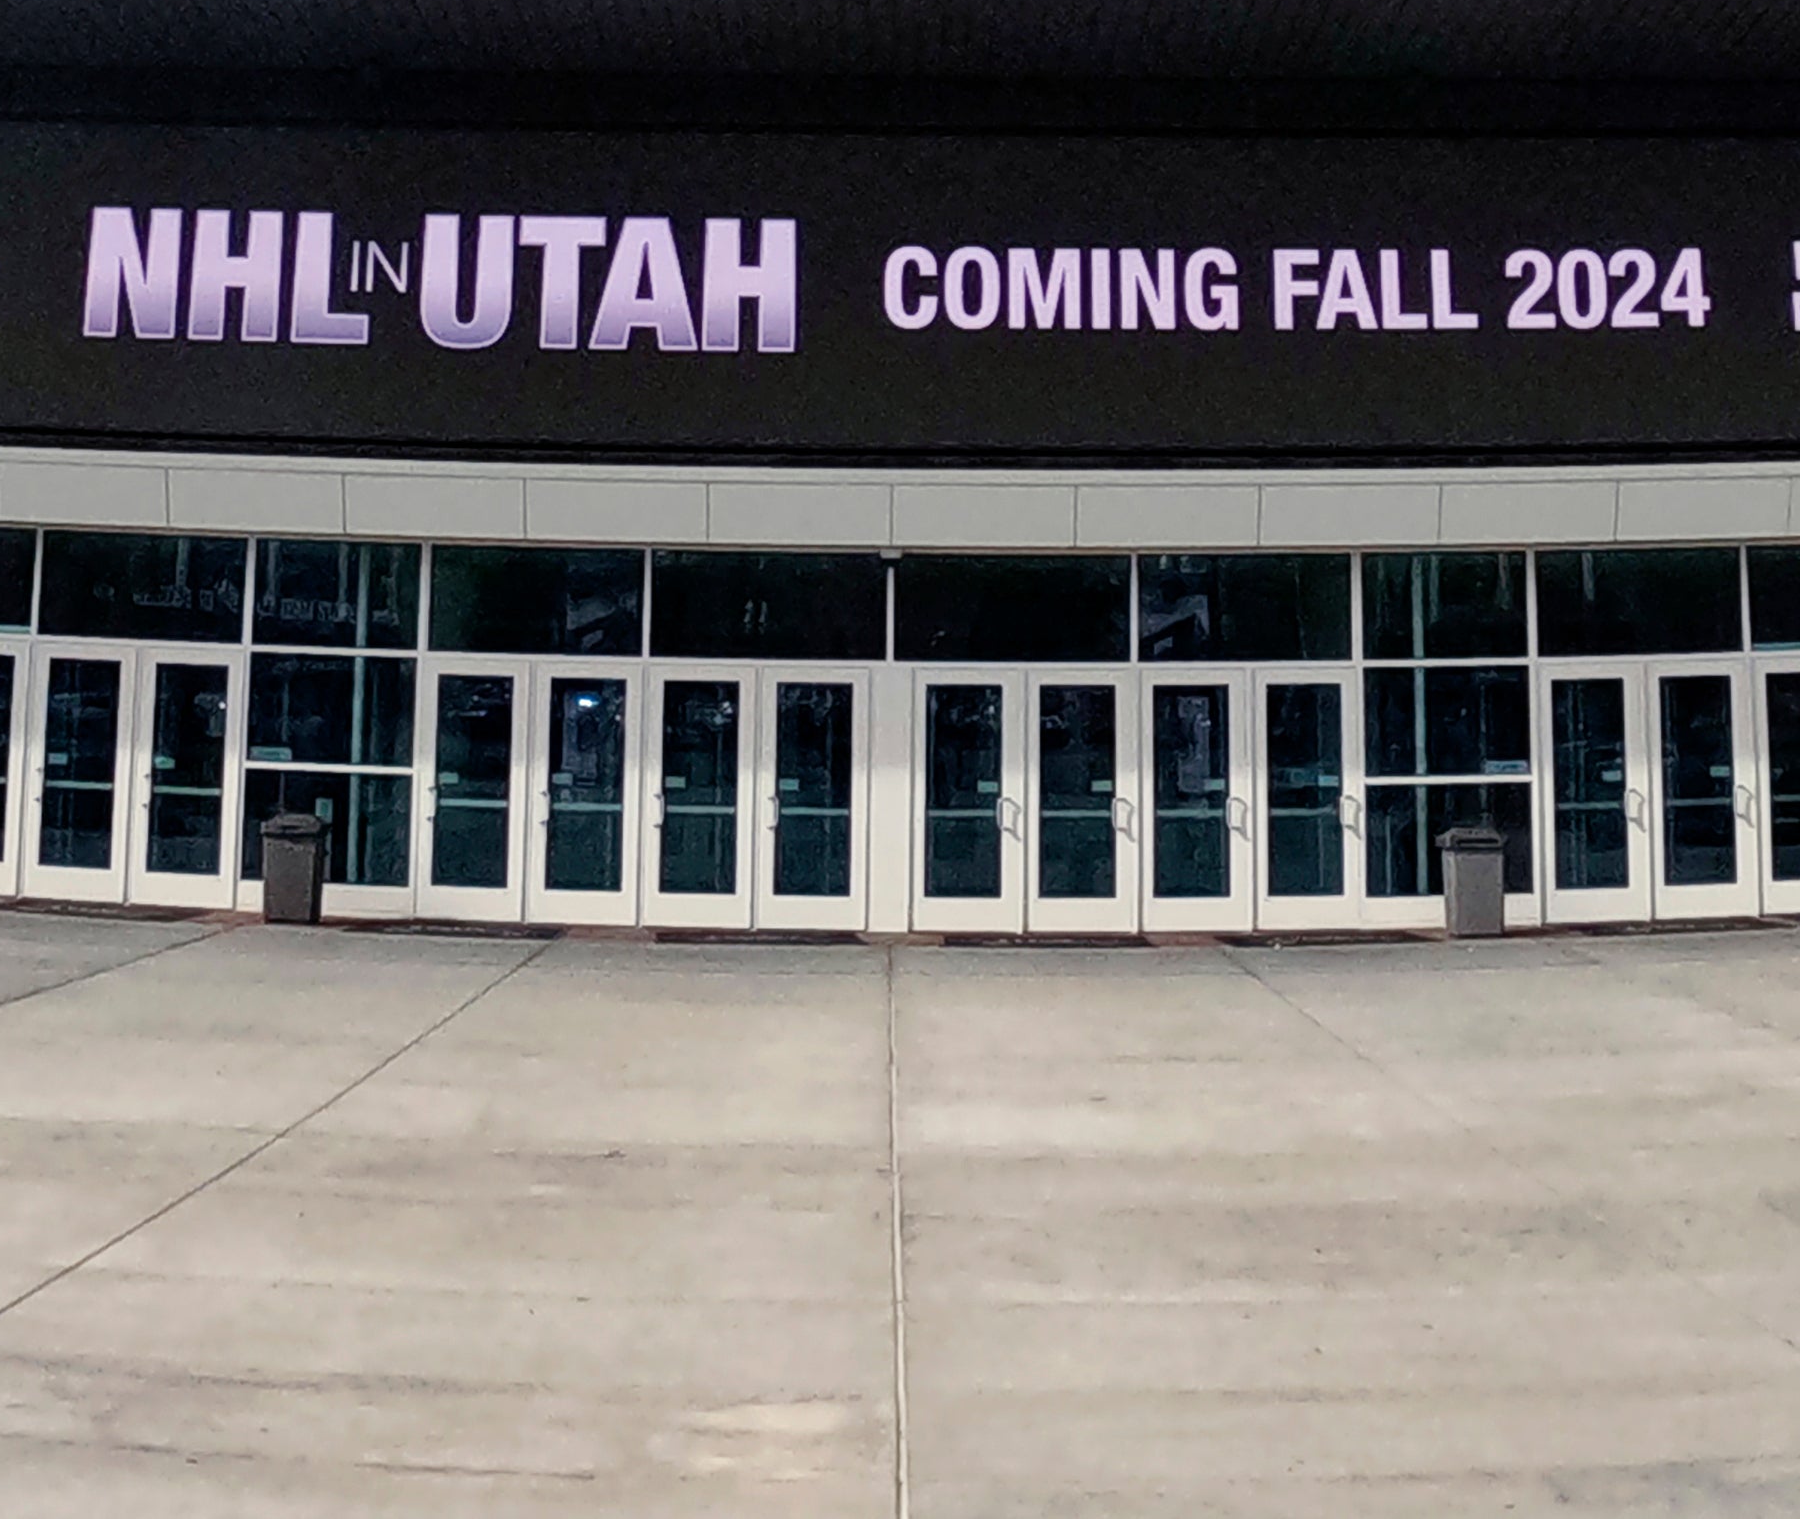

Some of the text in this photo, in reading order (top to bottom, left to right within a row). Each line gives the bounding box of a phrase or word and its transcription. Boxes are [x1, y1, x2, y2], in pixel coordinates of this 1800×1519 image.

[82, 206, 797, 353] NHL IN UTAH
[882, 246, 1711, 331] COMING FALL 2024
